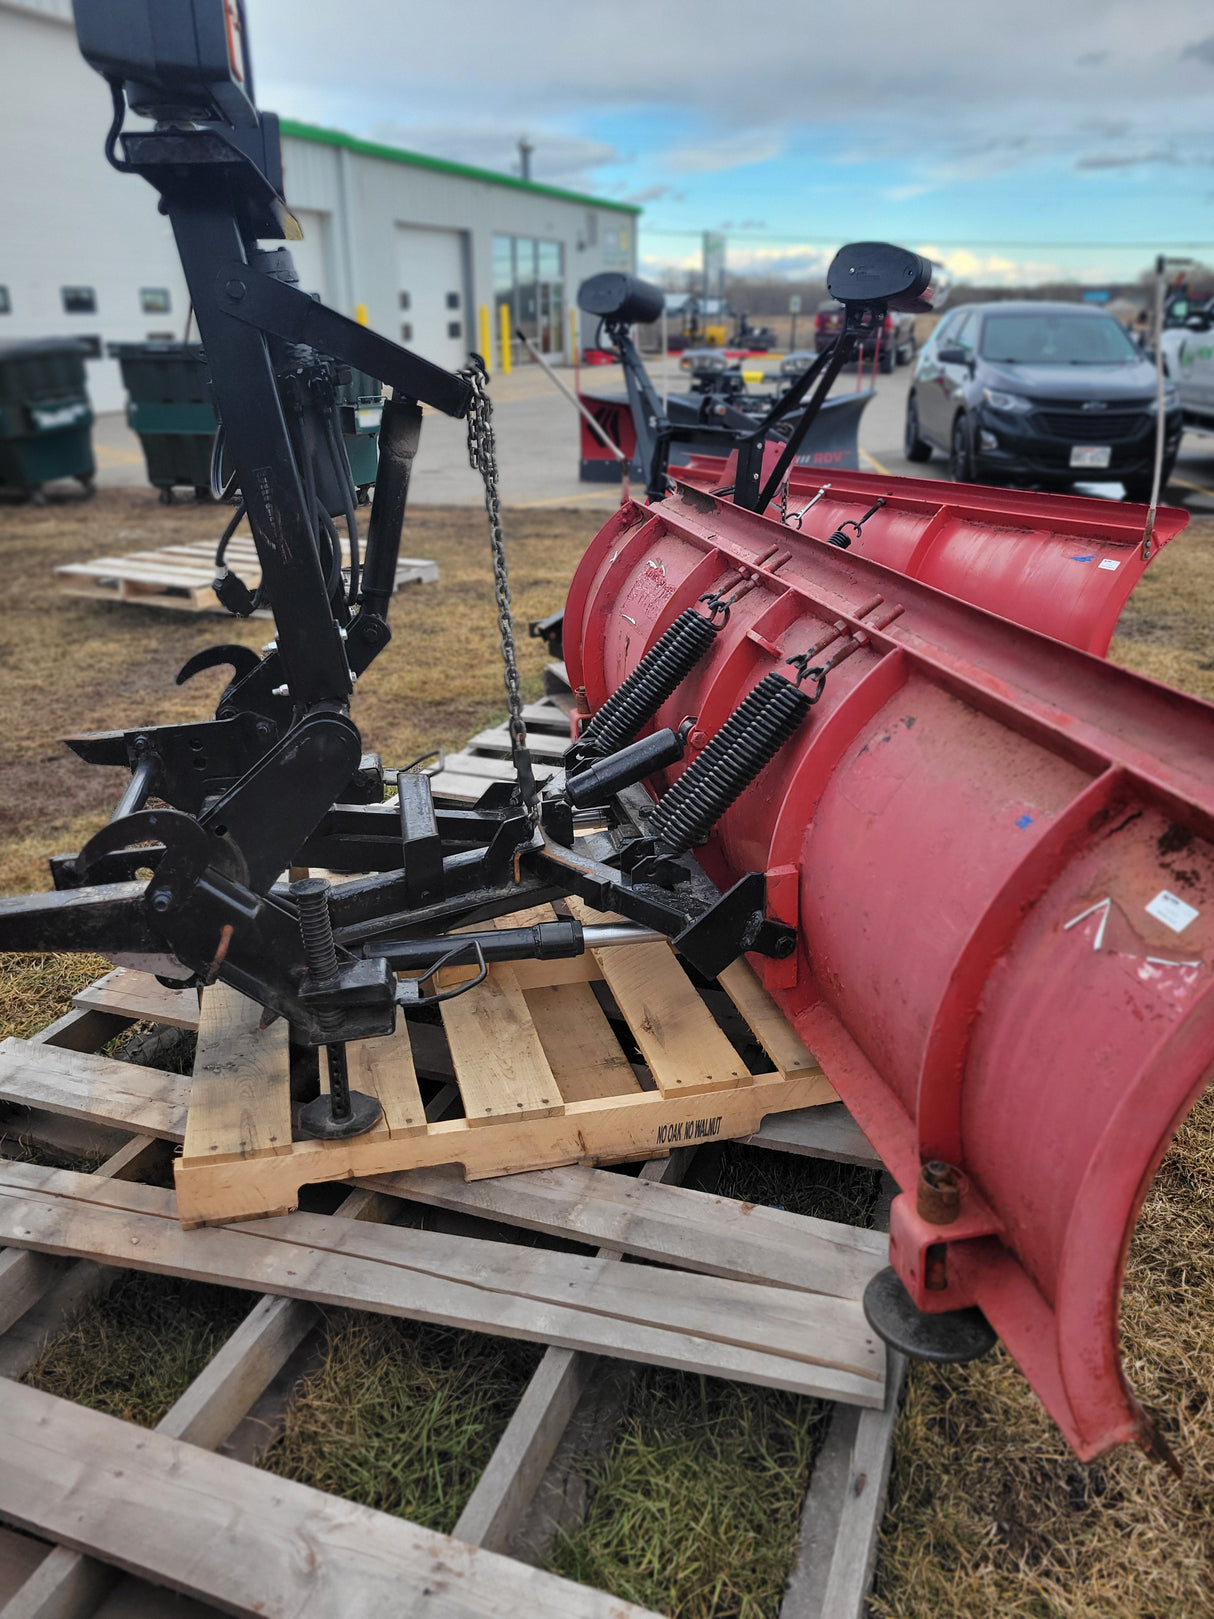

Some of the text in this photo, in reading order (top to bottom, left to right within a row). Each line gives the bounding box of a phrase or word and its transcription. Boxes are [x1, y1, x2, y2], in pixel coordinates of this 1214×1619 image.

[657, 1116, 722, 1144] NO OAK NO WALNUT
